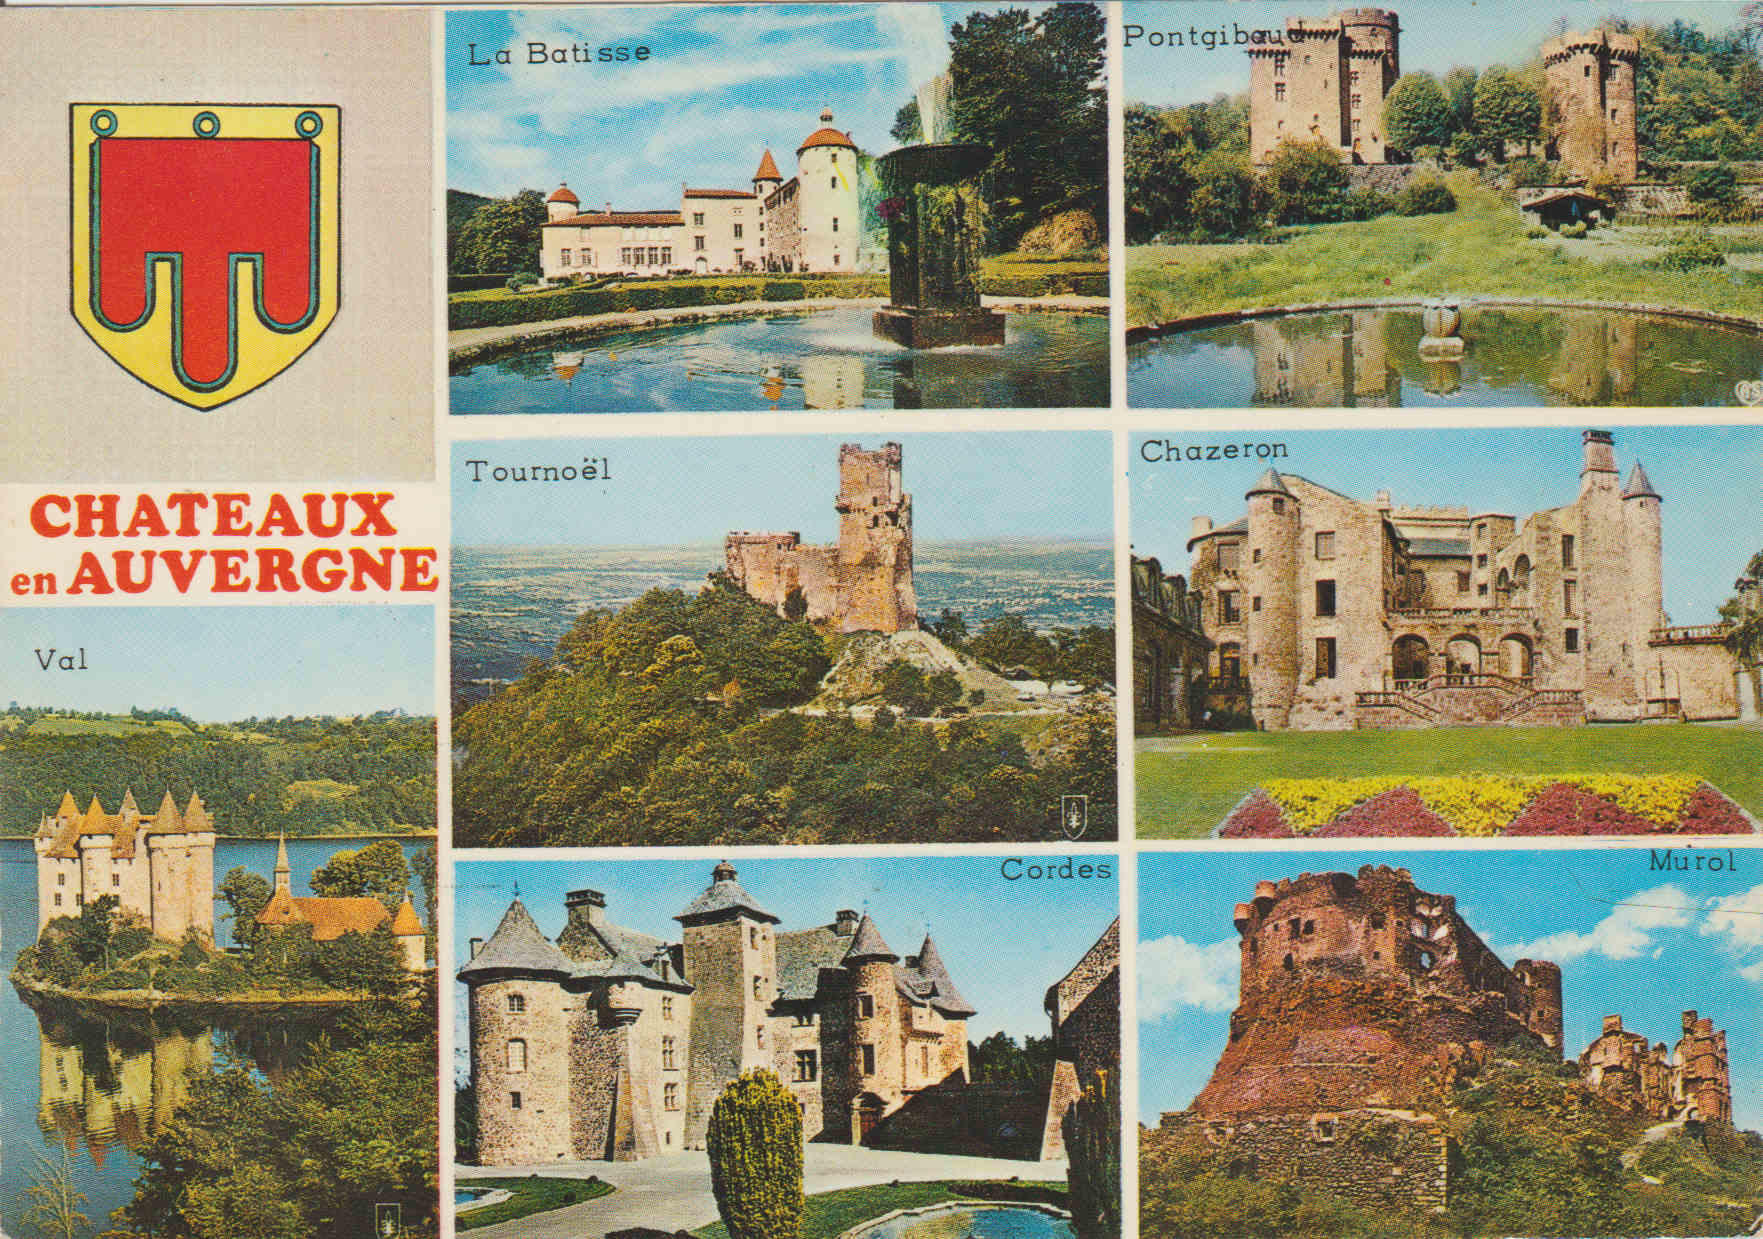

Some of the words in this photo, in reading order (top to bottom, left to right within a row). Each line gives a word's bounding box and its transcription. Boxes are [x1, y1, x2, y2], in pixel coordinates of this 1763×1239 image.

[1123, 19, 1305, 50] Pontgibaud
[468, 43, 511, 65] La
[527, 42, 650, 64] Batisse
[1141, 439, 1289, 462] Chazeron
[465, 456, 612, 482] Tournoël
[30, 492, 398, 538] CHATEAUX
[10, 573, 58, 596] en
[66, 547, 440, 595] AUVERGNE
[34, 647, 88, 671] Val
[1001, 856, 1112, 880] Cordes
[1649, 849, 1737, 871] Murol
